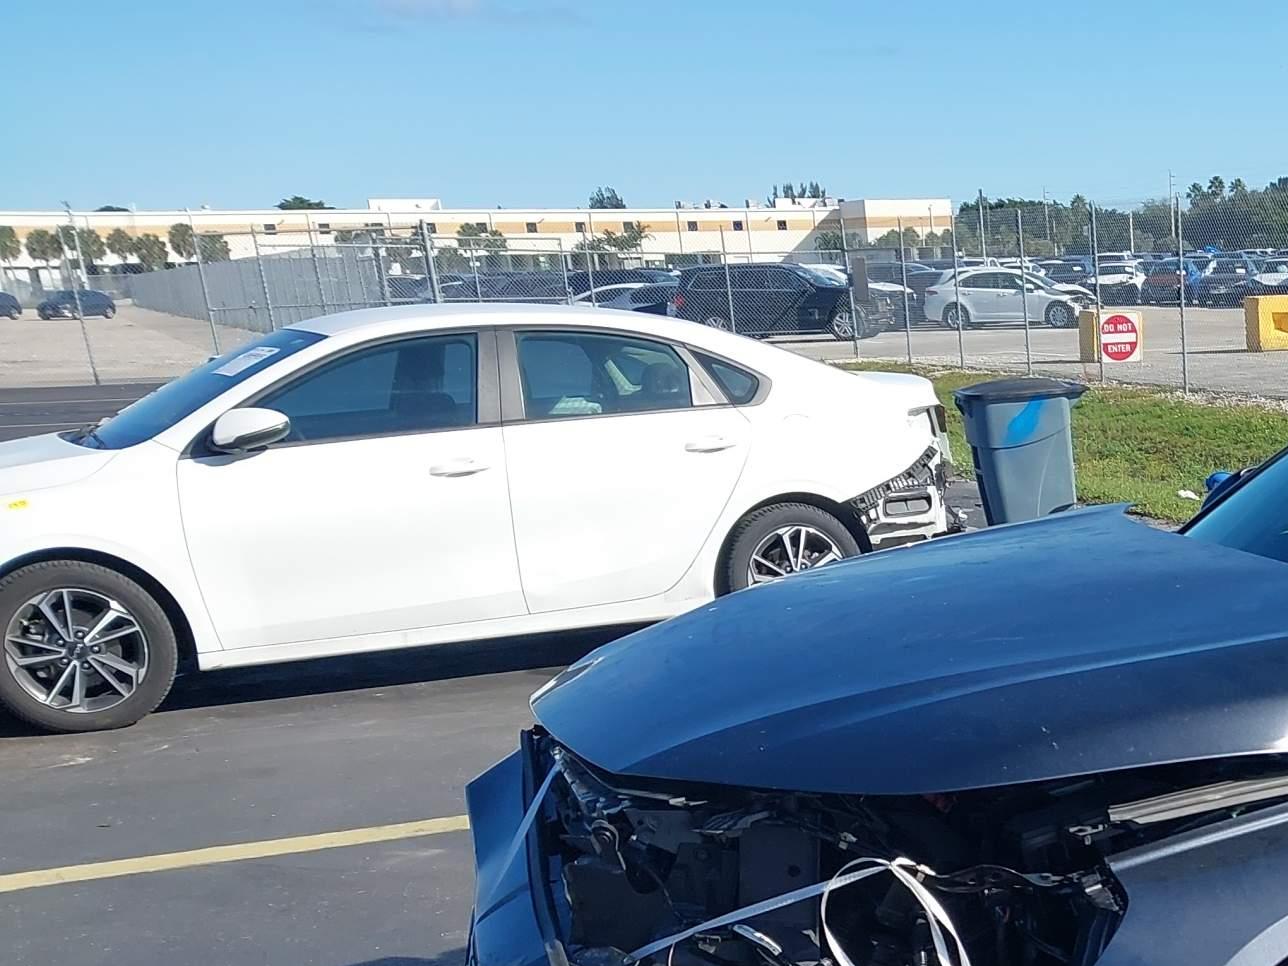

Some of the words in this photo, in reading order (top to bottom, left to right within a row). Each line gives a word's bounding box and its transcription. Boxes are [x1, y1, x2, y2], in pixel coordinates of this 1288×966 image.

[1104, 324, 1115, 332] DO
[1117, 323, 1132, 331] NOT
[1107, 344, 1130, 352] ENTER
